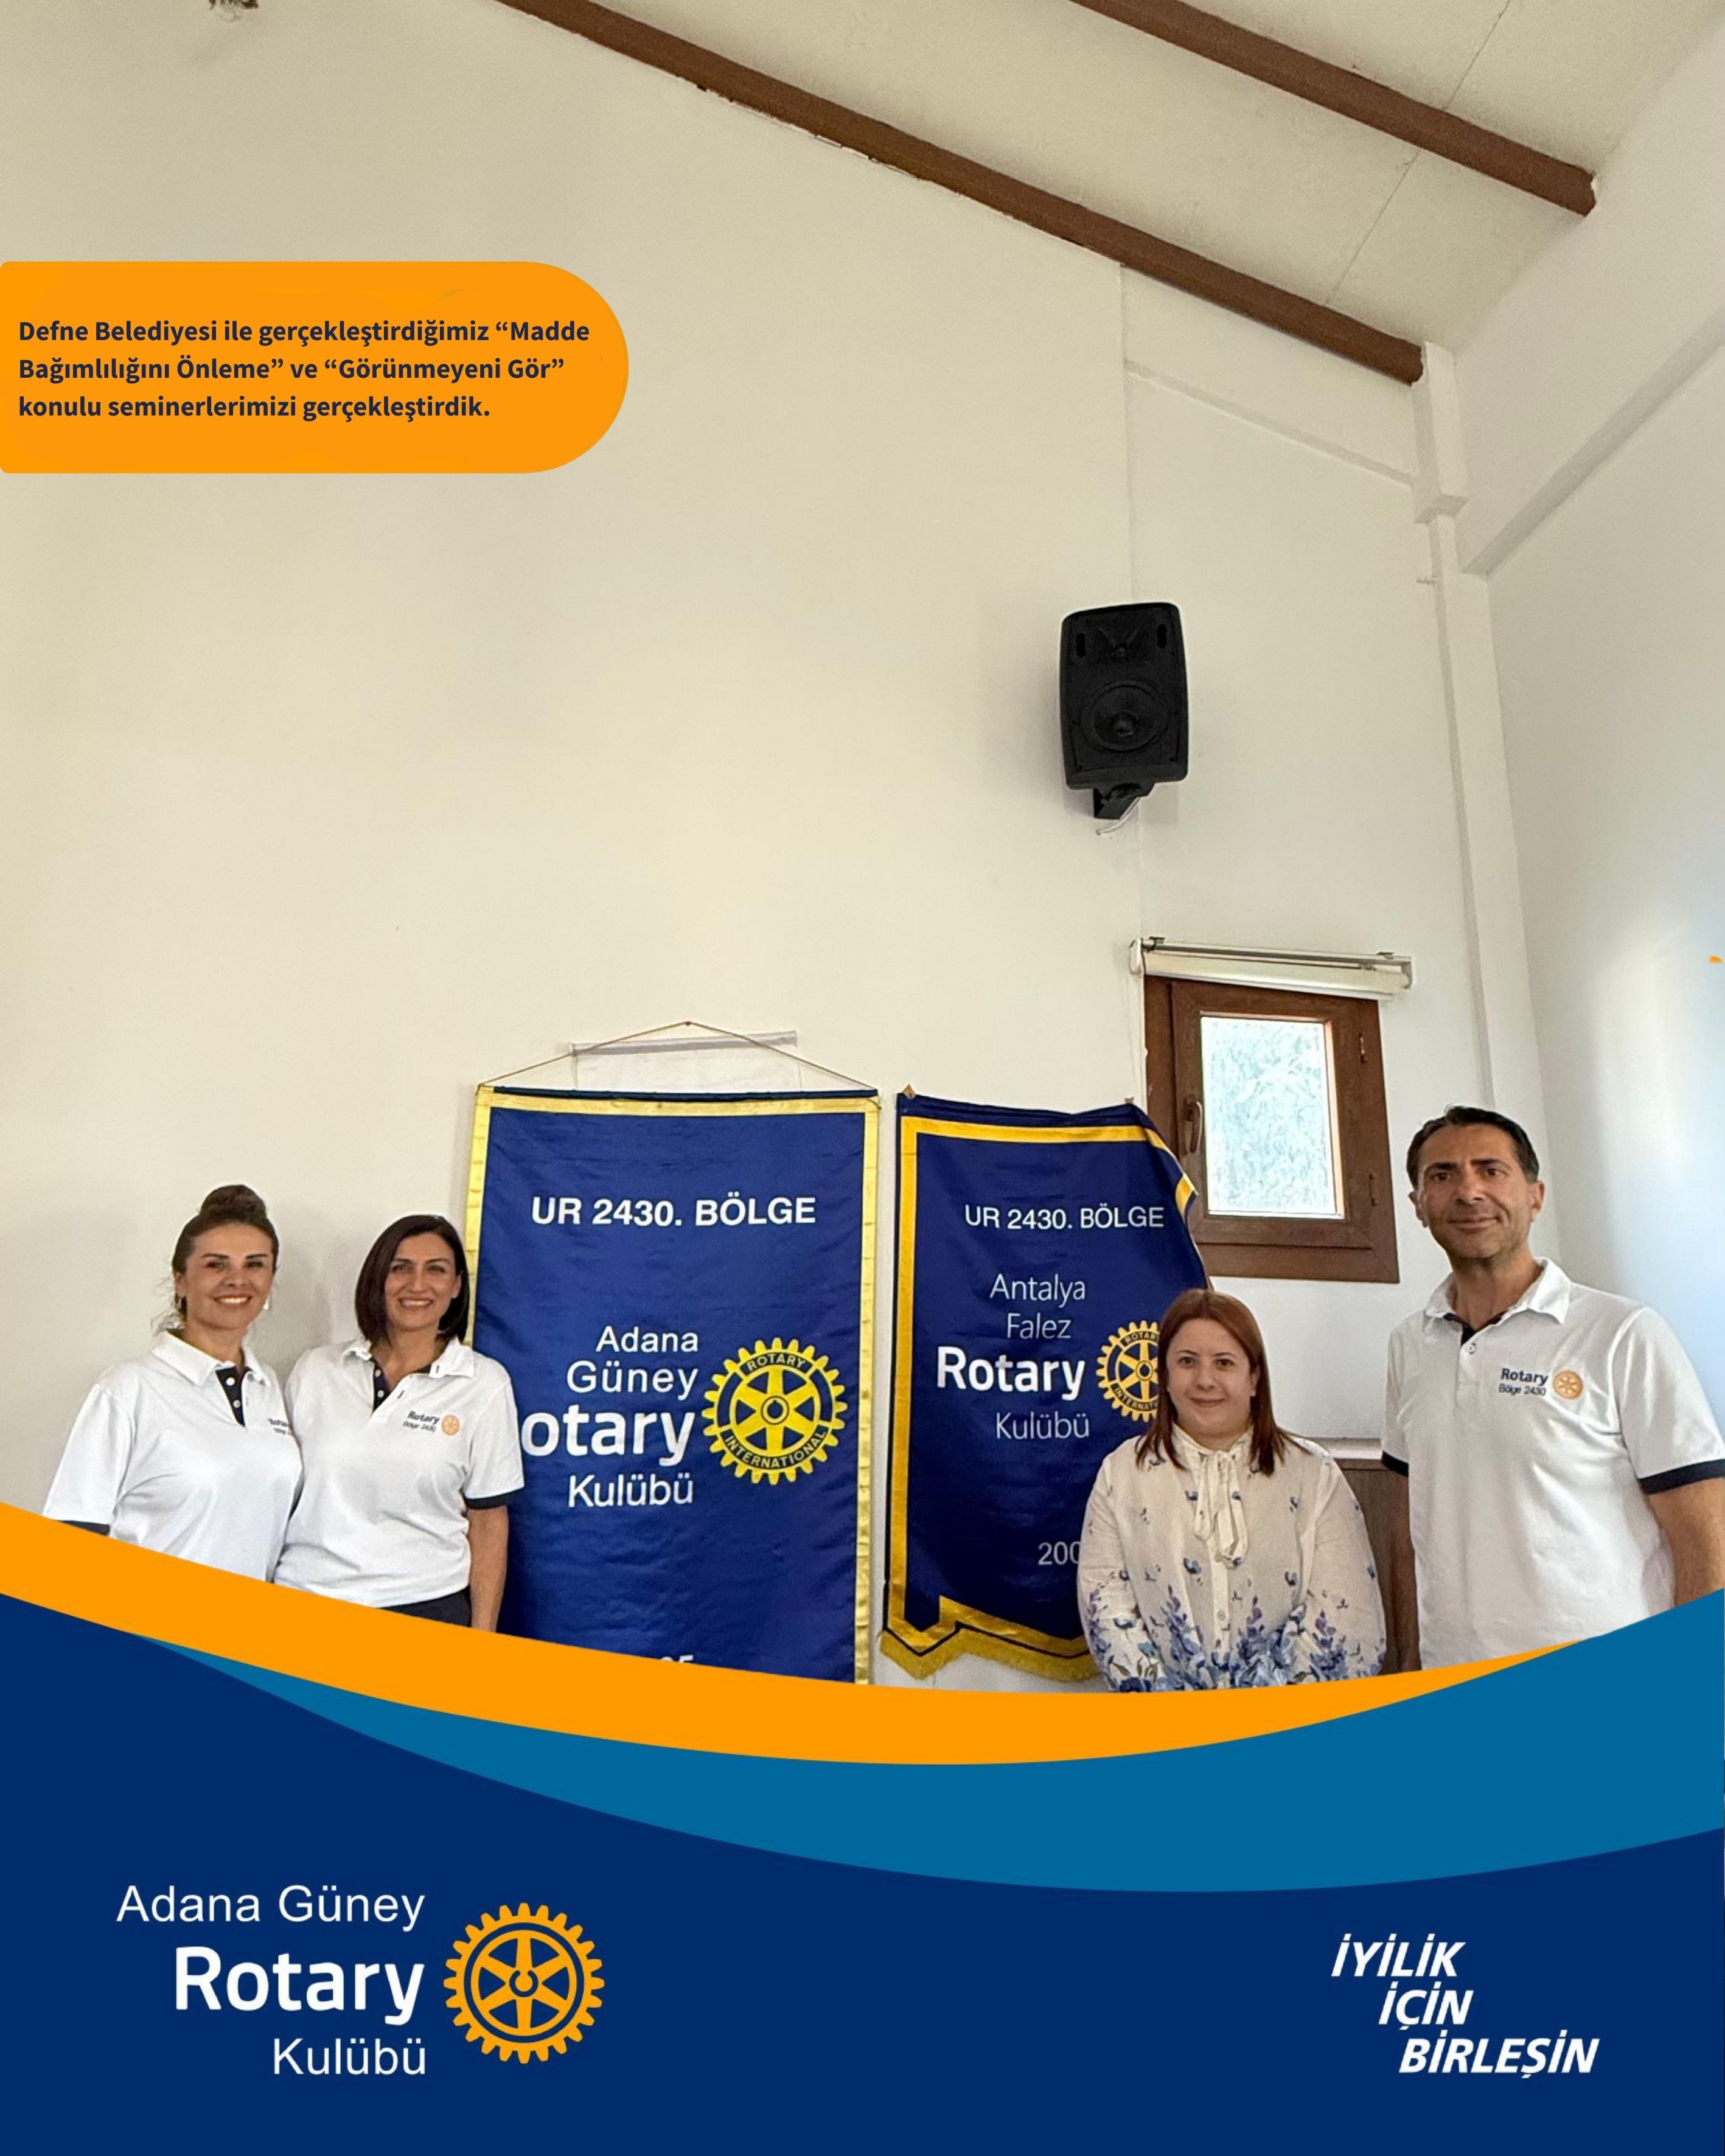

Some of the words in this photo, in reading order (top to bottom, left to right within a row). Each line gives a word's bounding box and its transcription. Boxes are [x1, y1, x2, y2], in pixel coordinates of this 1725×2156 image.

[531, 1196, 582, 1225] UR
[591, 1198, 683, 1227] 2430.
[695, 1191, 817, 1226] BÖLGE
[964, 1203, 1000, 1229] UR
[1006, 1208, 1073, 1231] 2430.
[1079, 1202, 1165, 1229] BÖLGE
[989, 1273, 1086, 1309] Antalya
[595, 1325, 699, 1353] Adana
[1006, 1312, 1072, 1340] Falez
[746, 1353, 806, 1371] ROTARY
[936, 1345, 1086, 1402] Rotary
[1500, 1368, 1549, 1386] Rotary
[566, 1360, 699, 1402] Güney
[521, 1403, 697, 1467] otary
[996, 1410, 1090, 1441] Kulübü
[724, 1431, 826, 1469] INTERNATIONAL
[568, 1472, 694, 1508] Kulübü
